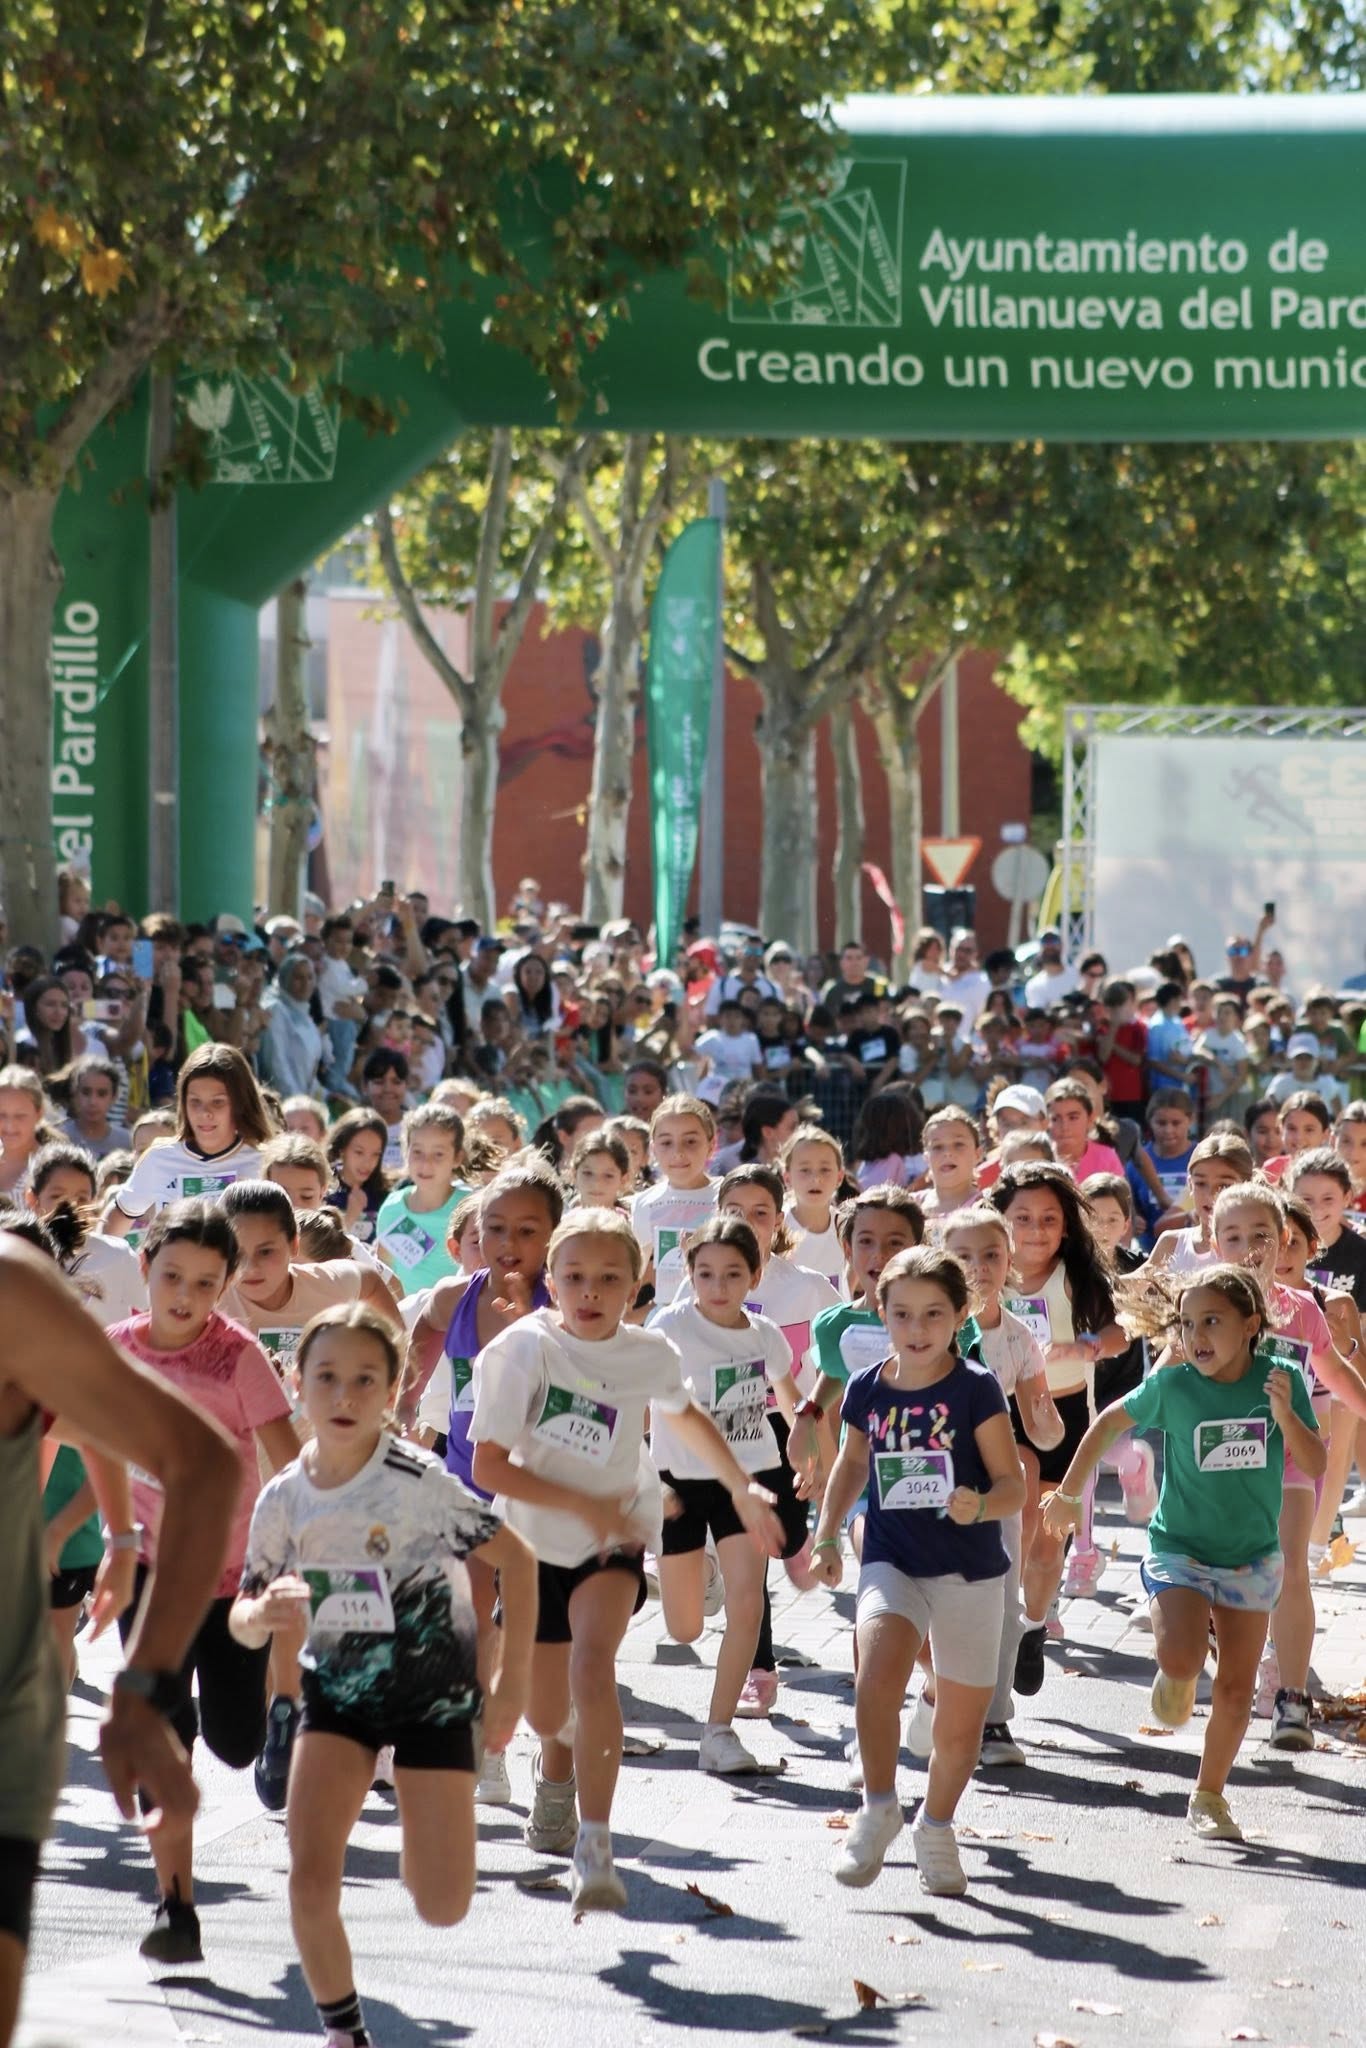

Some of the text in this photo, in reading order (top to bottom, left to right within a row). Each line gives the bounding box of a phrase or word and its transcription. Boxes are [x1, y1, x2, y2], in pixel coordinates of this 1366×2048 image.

[920, 228, 1248, 280] Ayuntamiento
[1268, 228, 1329, 274] de
[920, 286, 1163, 330] Villanueva
[1179, 286, 1253, 330] del
[698, 338, 924, 387] Creando
[944, 356, 1009, 388] un
[1031, 356, 1193, 390] nuevo
[52, 601, 100, 880] el Pardillo
[569, 1420, 601, 1443] 1276
[1224, 1445, 1256, 1458] 3069
[906, 1481, 939, 1495] 3042
[341, 1599, 369, 1615] 114
